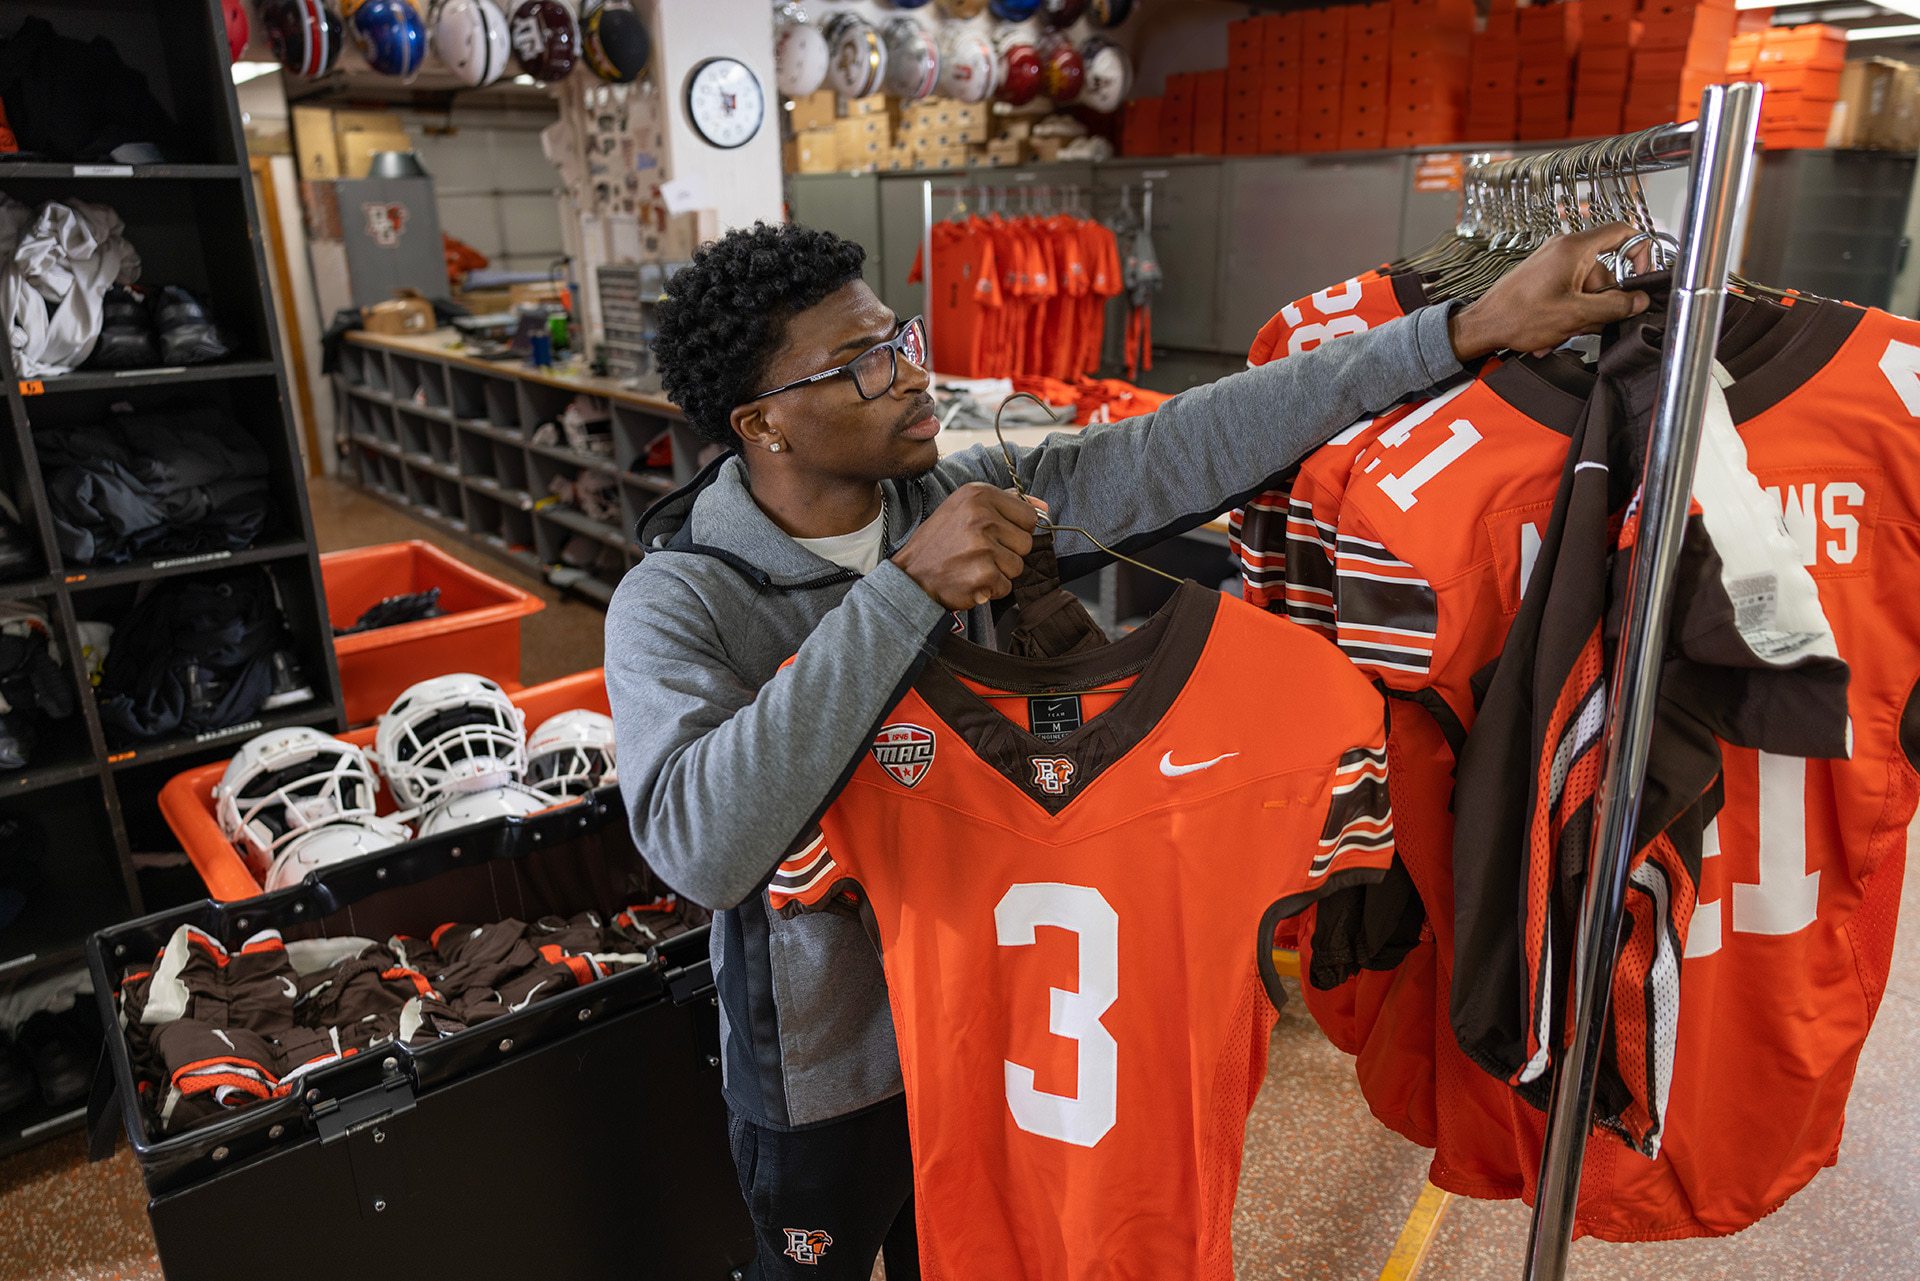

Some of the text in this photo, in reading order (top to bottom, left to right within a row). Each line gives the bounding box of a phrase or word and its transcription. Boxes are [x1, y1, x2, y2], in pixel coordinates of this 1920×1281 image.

[1052, 722, 1061, 732] M
[876, 744, 934, 762] MAC
[993, 882, 1120, 1148] 3
